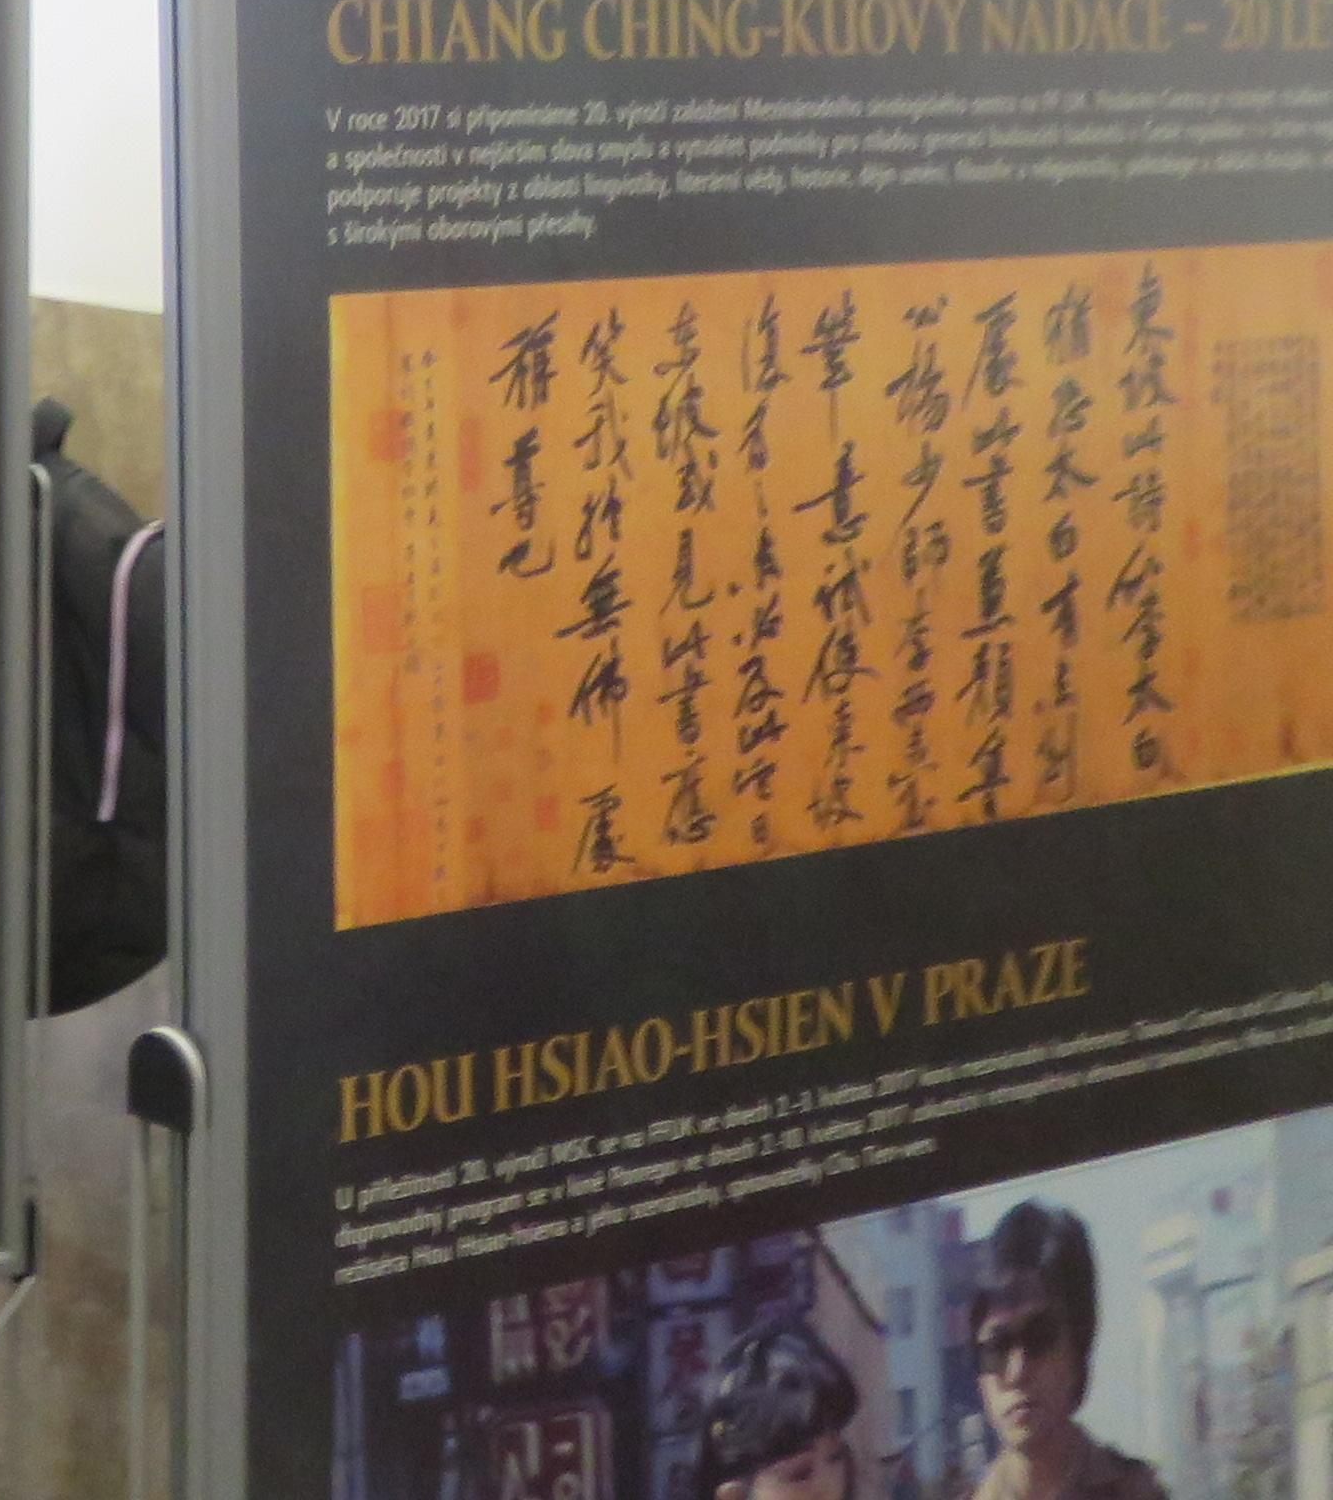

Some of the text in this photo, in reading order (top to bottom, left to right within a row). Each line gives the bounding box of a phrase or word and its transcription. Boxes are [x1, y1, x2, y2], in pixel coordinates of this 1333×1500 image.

[325, 106, 342, 132] V
[347, 111, 388, 133] roce
[395, 103, 442, 132] 2017
[326, 151, 339, 171] a
[338, 1053, 477, 1144] HOU
[492, 981, 855, 1114] HSIAO-HSIEN
[868, 972, 907, 1038] V
[921, 937, 1093, 1027] PRAZE
